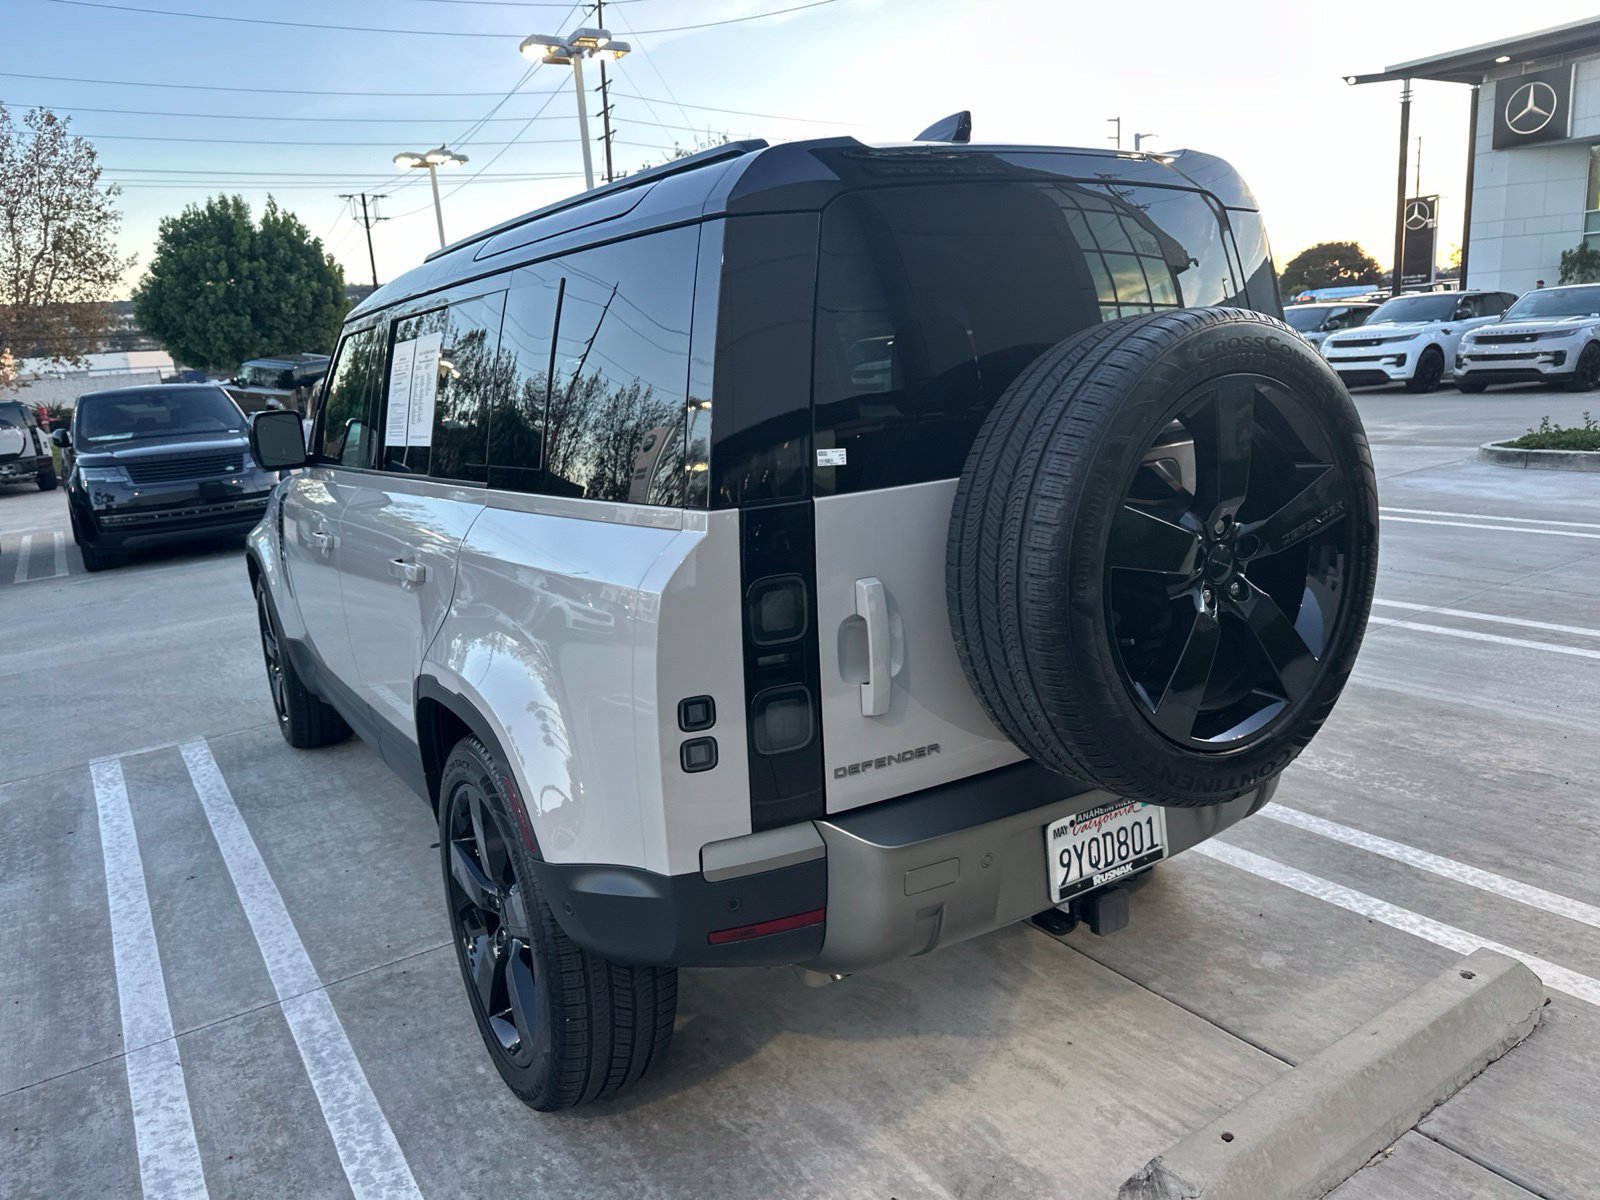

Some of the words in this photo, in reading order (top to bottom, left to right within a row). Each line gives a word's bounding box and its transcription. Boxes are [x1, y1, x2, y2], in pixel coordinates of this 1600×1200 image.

[834, 743, 941, 779] DEFENDER
[1053, 825, 1069, 840] MAY
[1072, 804, 1143, 836] California
[1059, 816, 1159, 887] 9YQD801
[1093, 862, 1134, 885] RUSNAK
